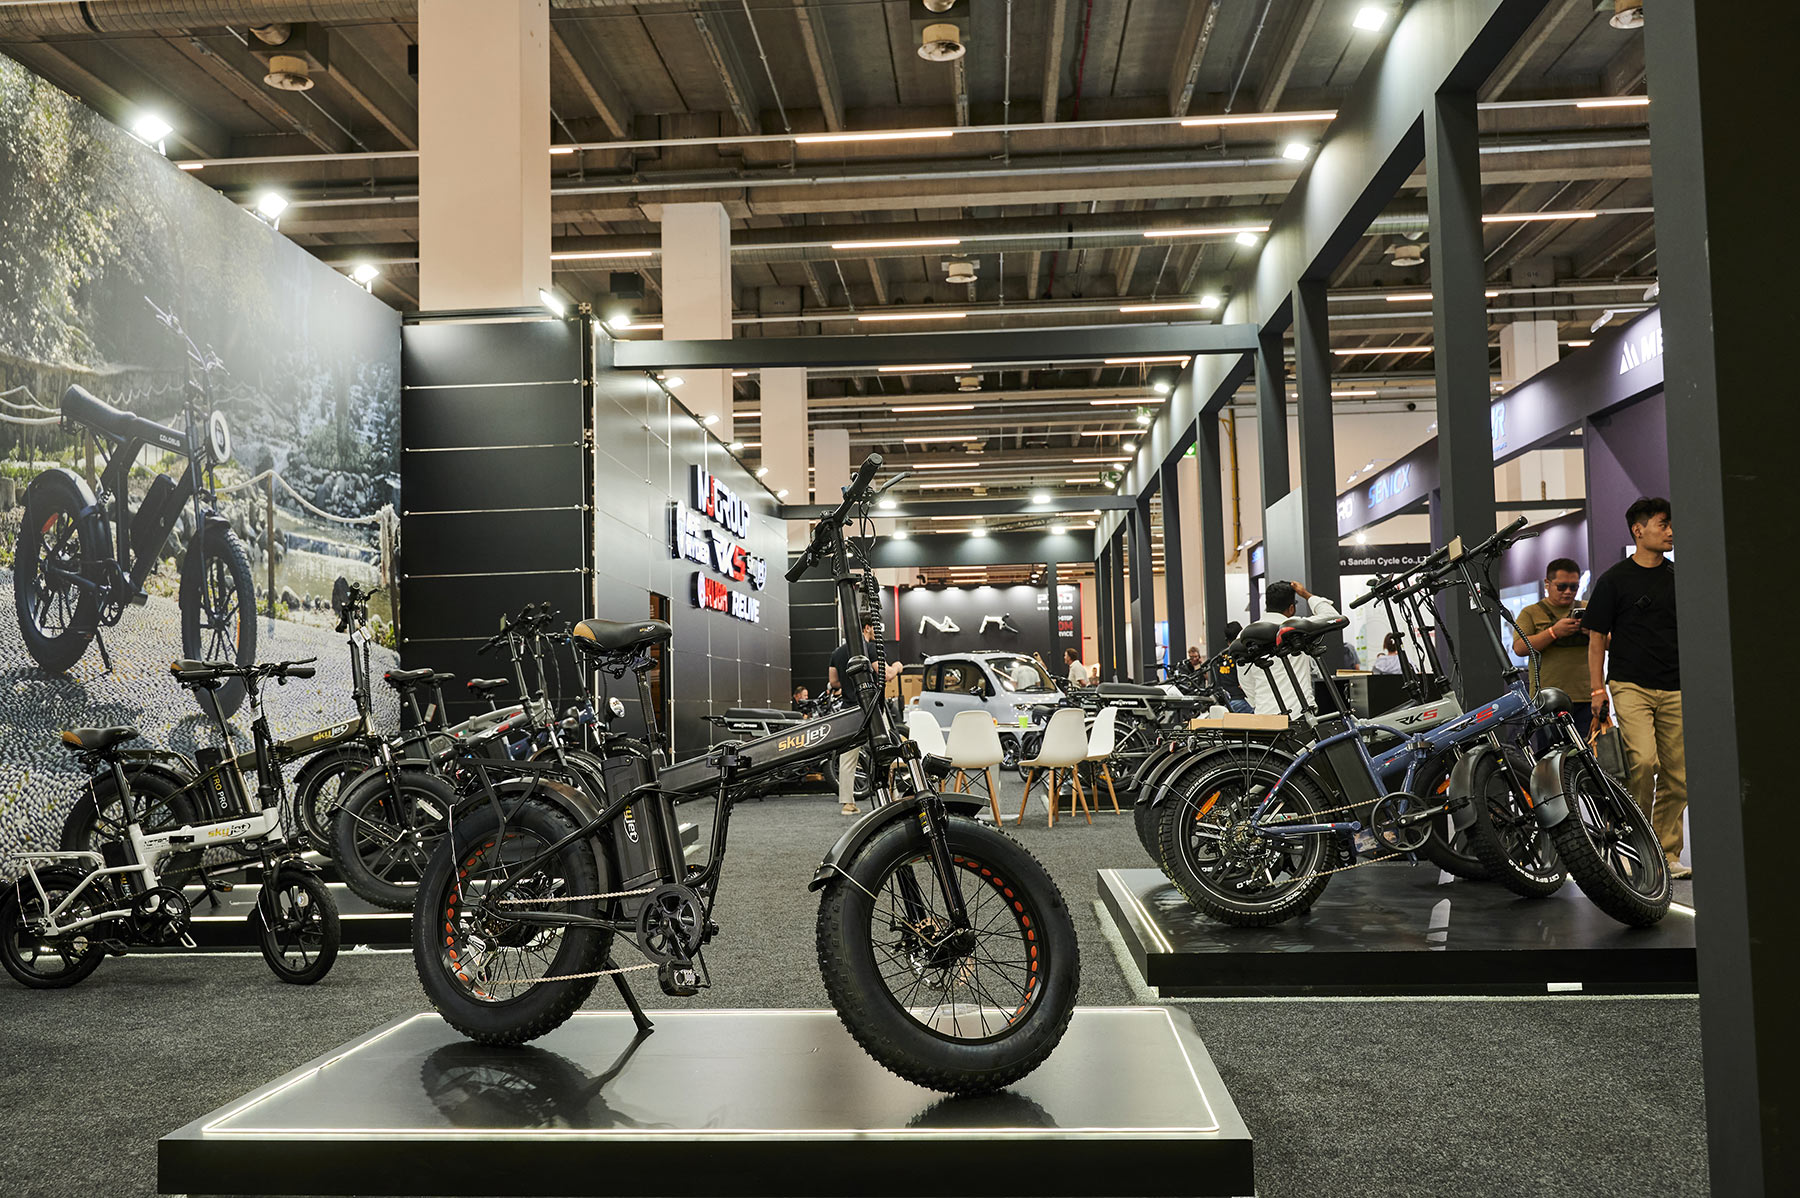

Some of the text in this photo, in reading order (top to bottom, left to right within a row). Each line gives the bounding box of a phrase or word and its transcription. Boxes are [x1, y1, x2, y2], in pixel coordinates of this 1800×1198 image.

[1367, 464, 1411, 509] SENICX
[1347, 557, 1376, 566] Sandin
[1377, 557, 1400, 566] Cycle
[1395, 708, 1438, 725] RKS
[312, 723, 349, 742] skyjet
[778, 723, 831, 752] skyjet
[217, 791, 228, 809] PRO
[208, 823, 251, 838] skyjet
